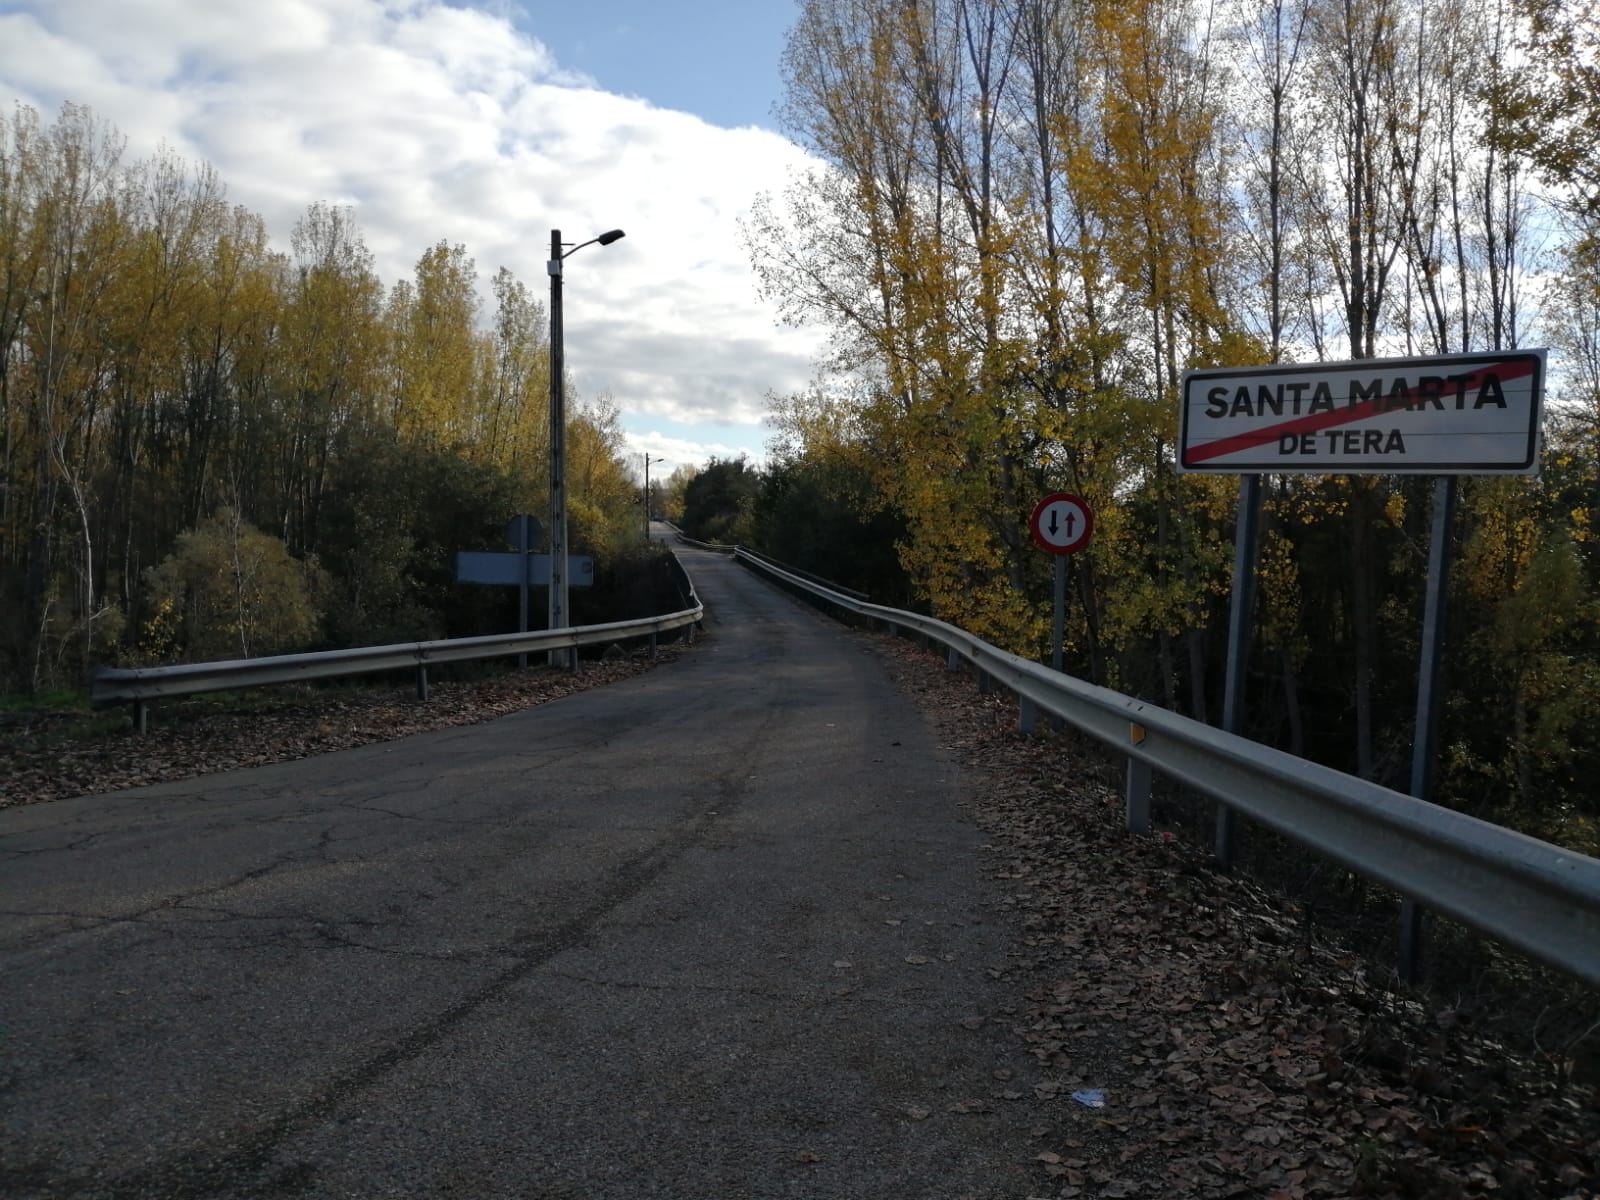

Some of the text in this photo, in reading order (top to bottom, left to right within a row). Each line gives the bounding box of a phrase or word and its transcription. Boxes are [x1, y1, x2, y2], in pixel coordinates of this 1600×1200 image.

[1205, 374, 1507, 418] SANTA MARTA
[1279, 430, 1406, 455] DE TERA
